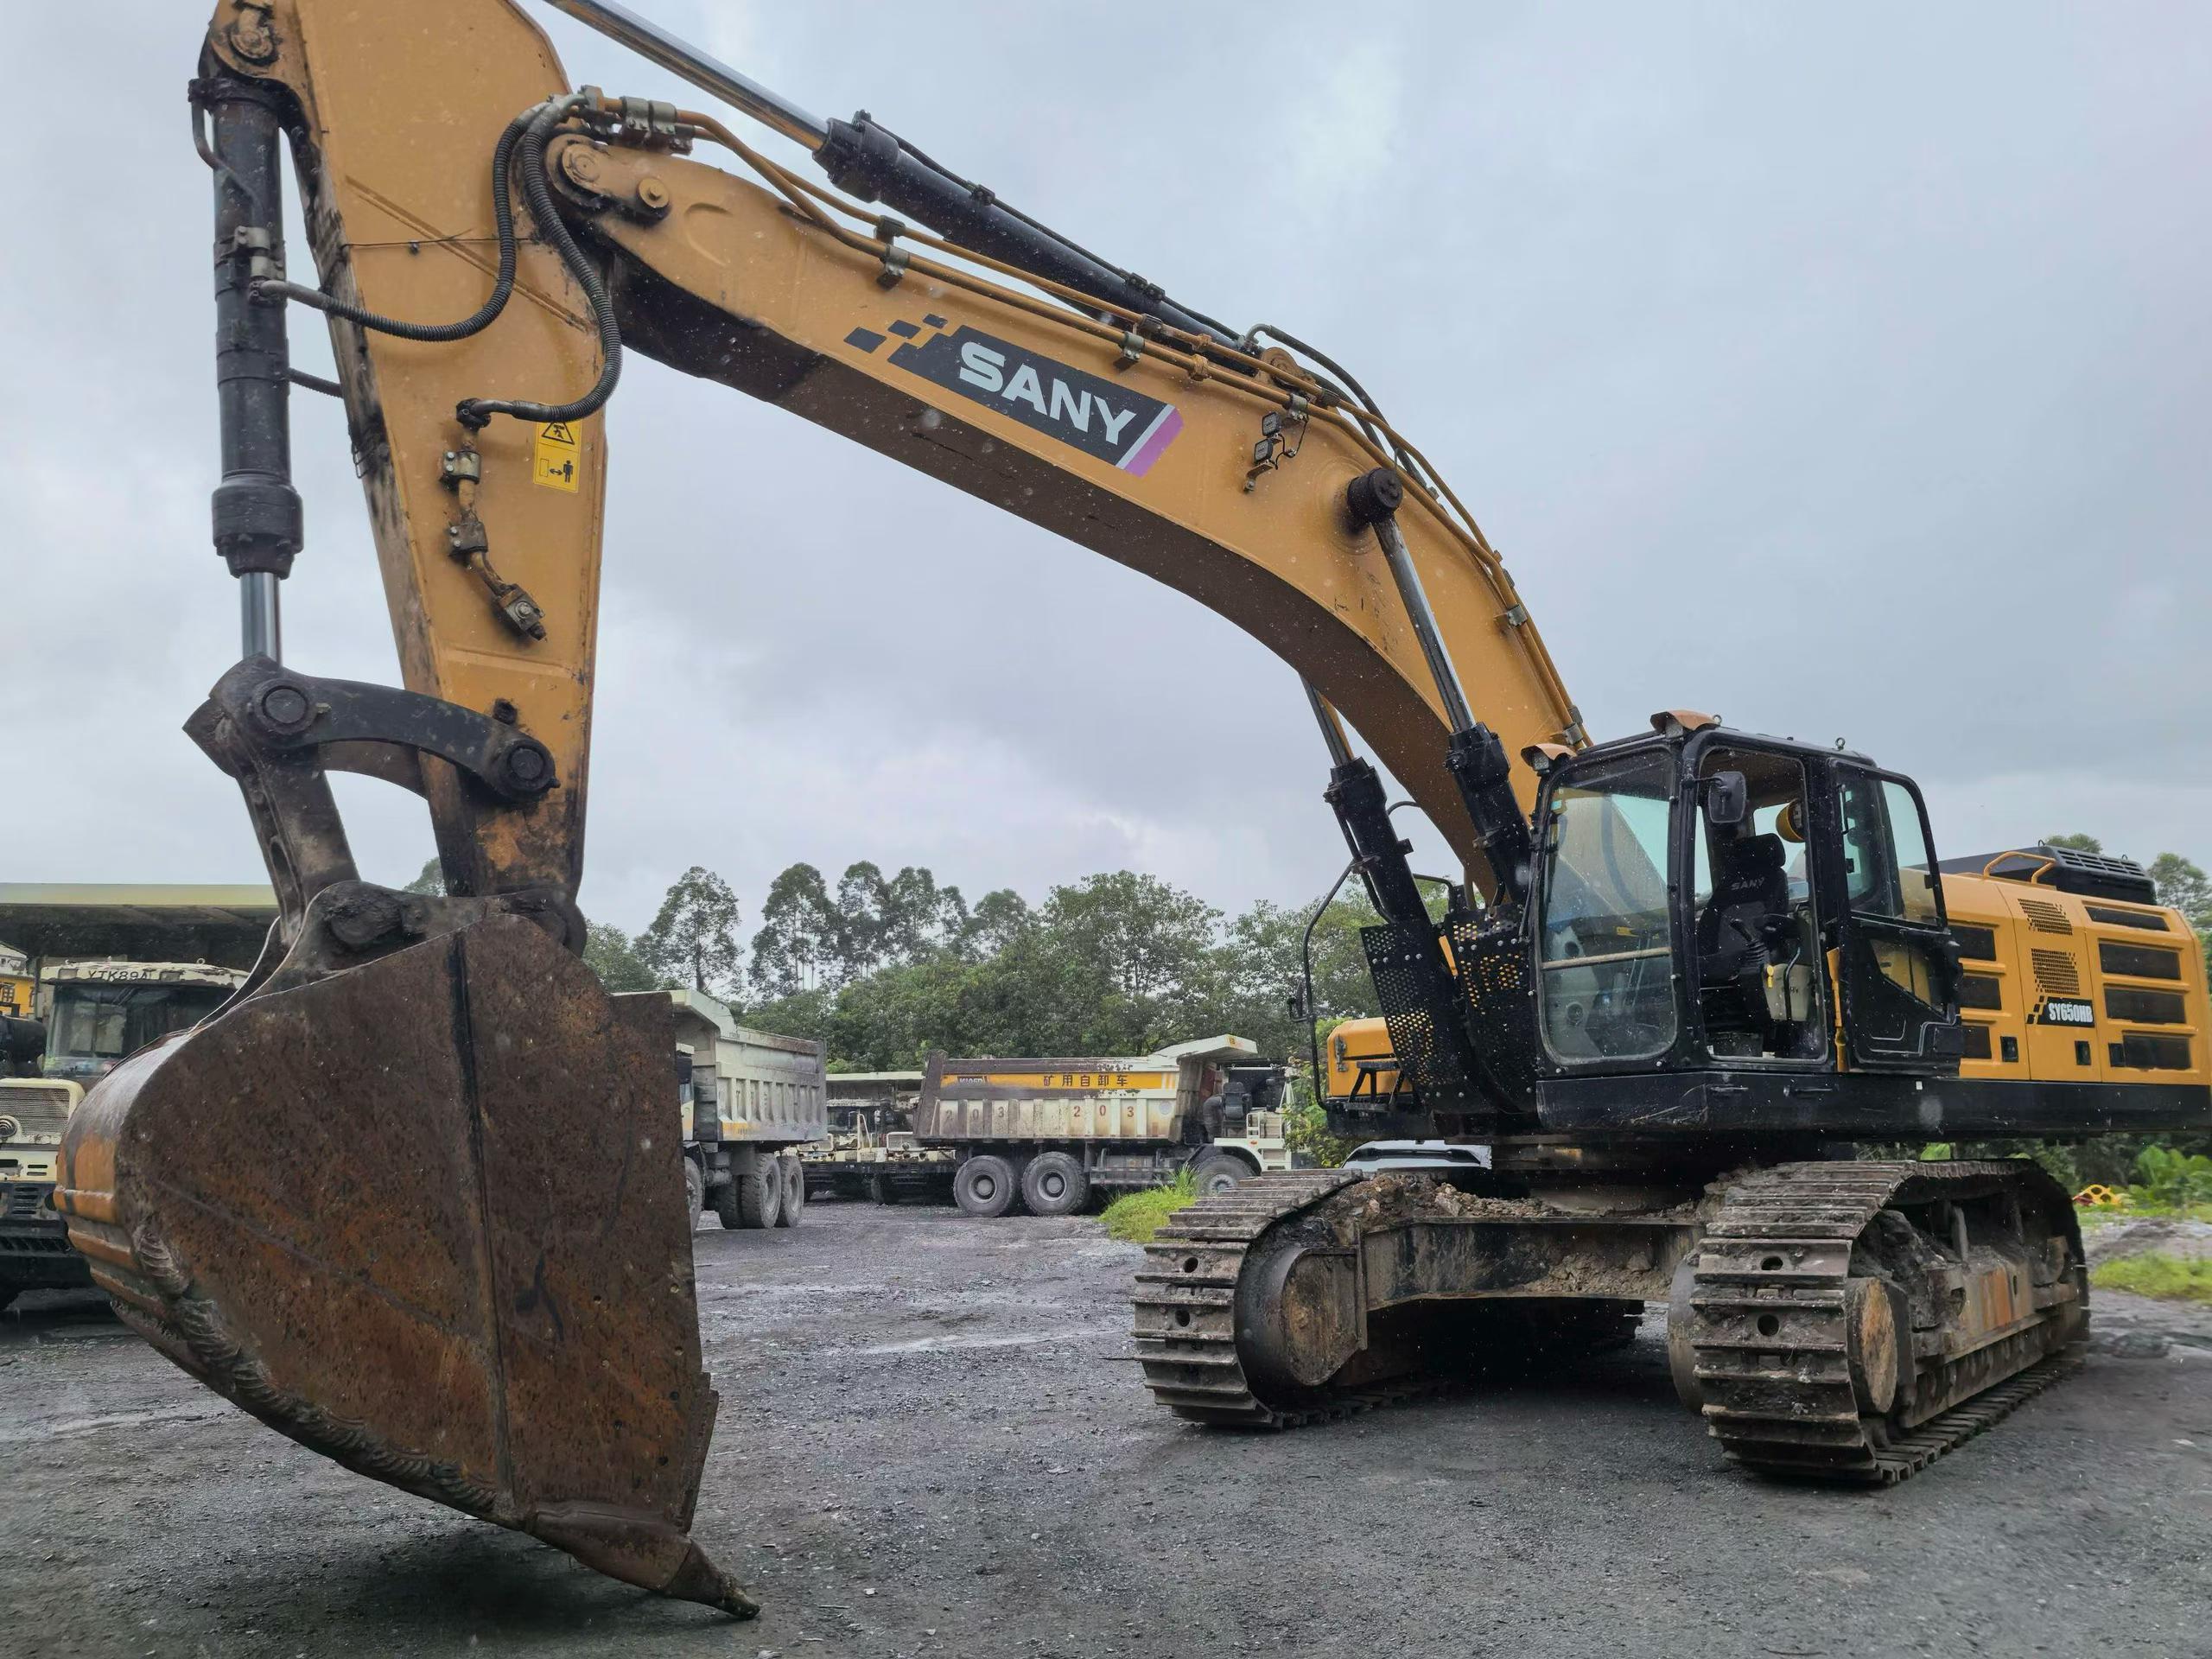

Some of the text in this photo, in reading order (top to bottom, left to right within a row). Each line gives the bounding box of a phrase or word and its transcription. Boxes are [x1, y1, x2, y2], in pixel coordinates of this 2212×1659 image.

[958, 341, 1137, 446] SANY
[1043, 1074, 1128, 1087] 矿用自卸车
